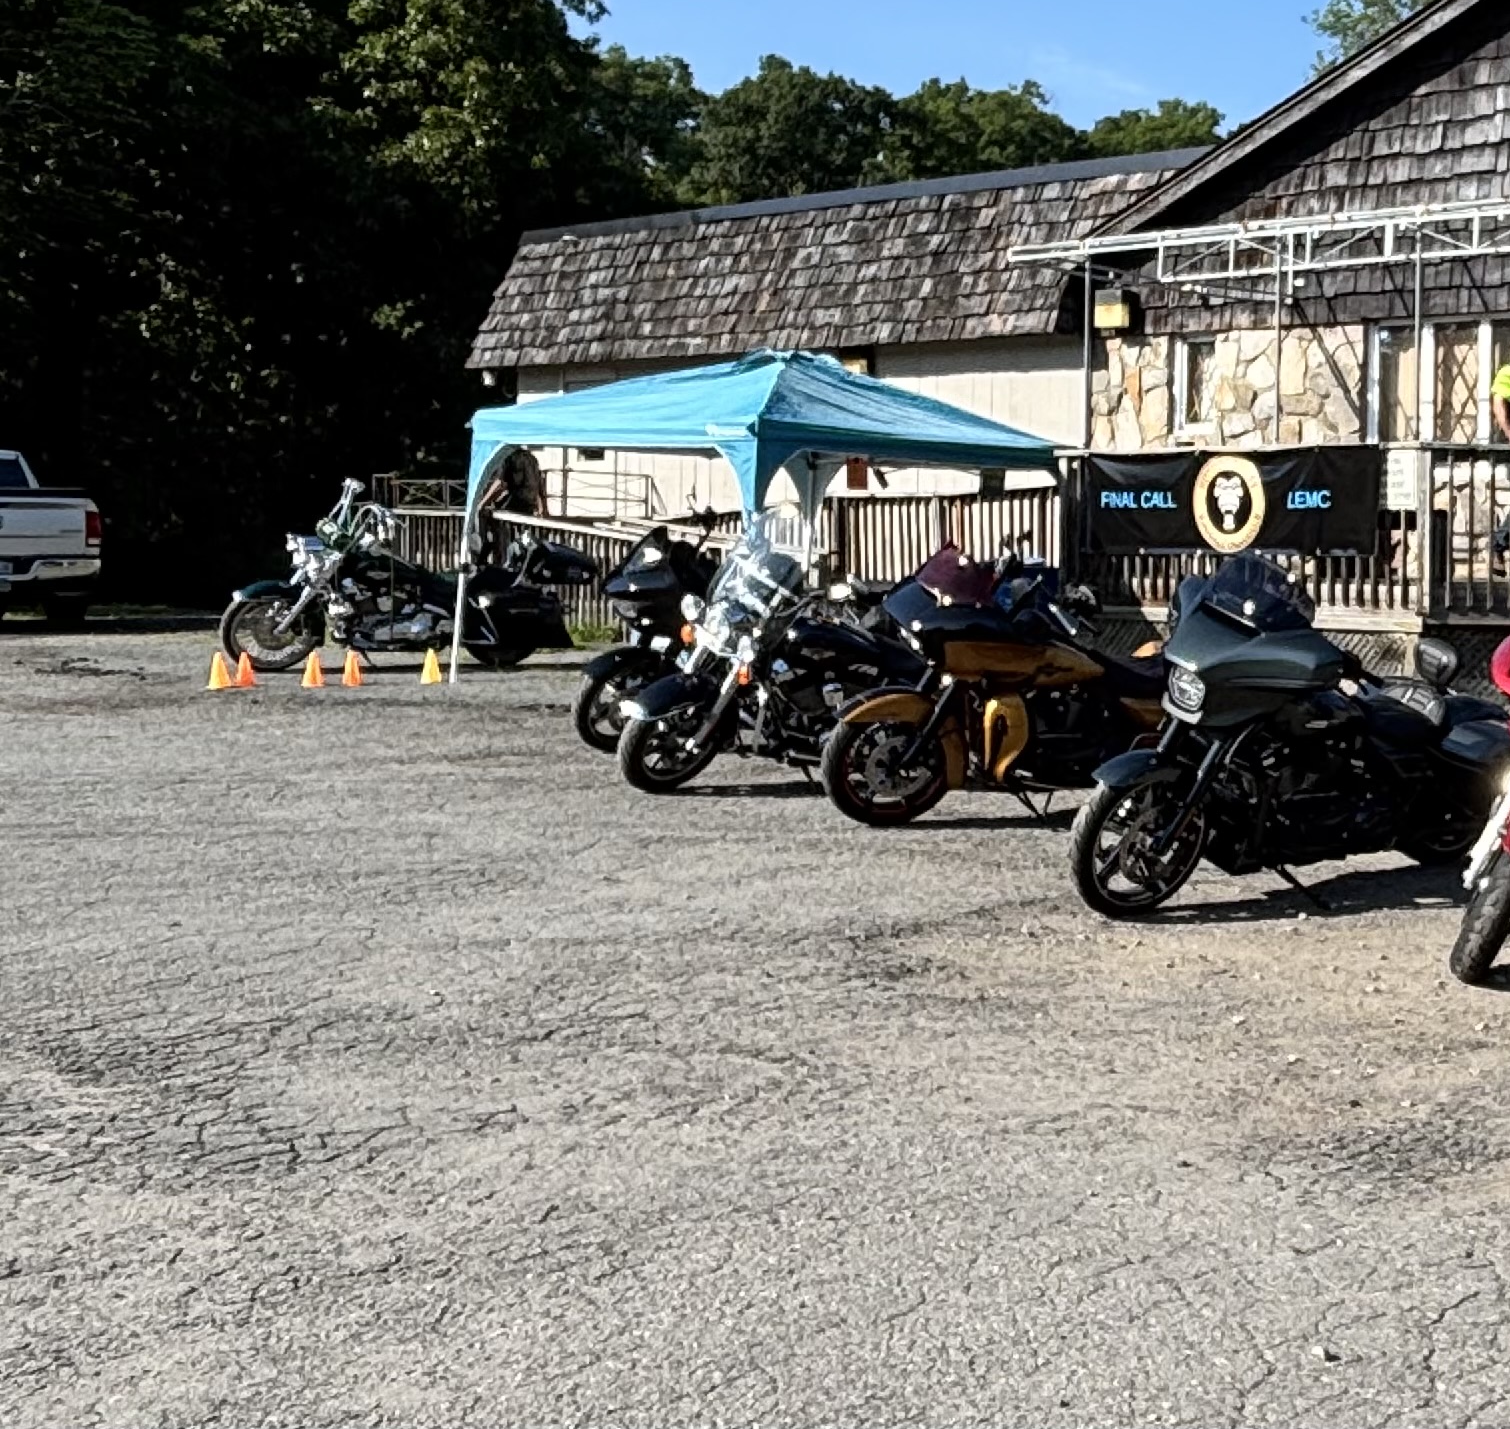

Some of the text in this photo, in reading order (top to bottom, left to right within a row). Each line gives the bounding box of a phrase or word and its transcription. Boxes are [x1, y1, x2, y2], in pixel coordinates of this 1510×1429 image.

[1100, 491, 1178, 509] FINAL CALL
[1287, 489, 1332, 509] LEMC
